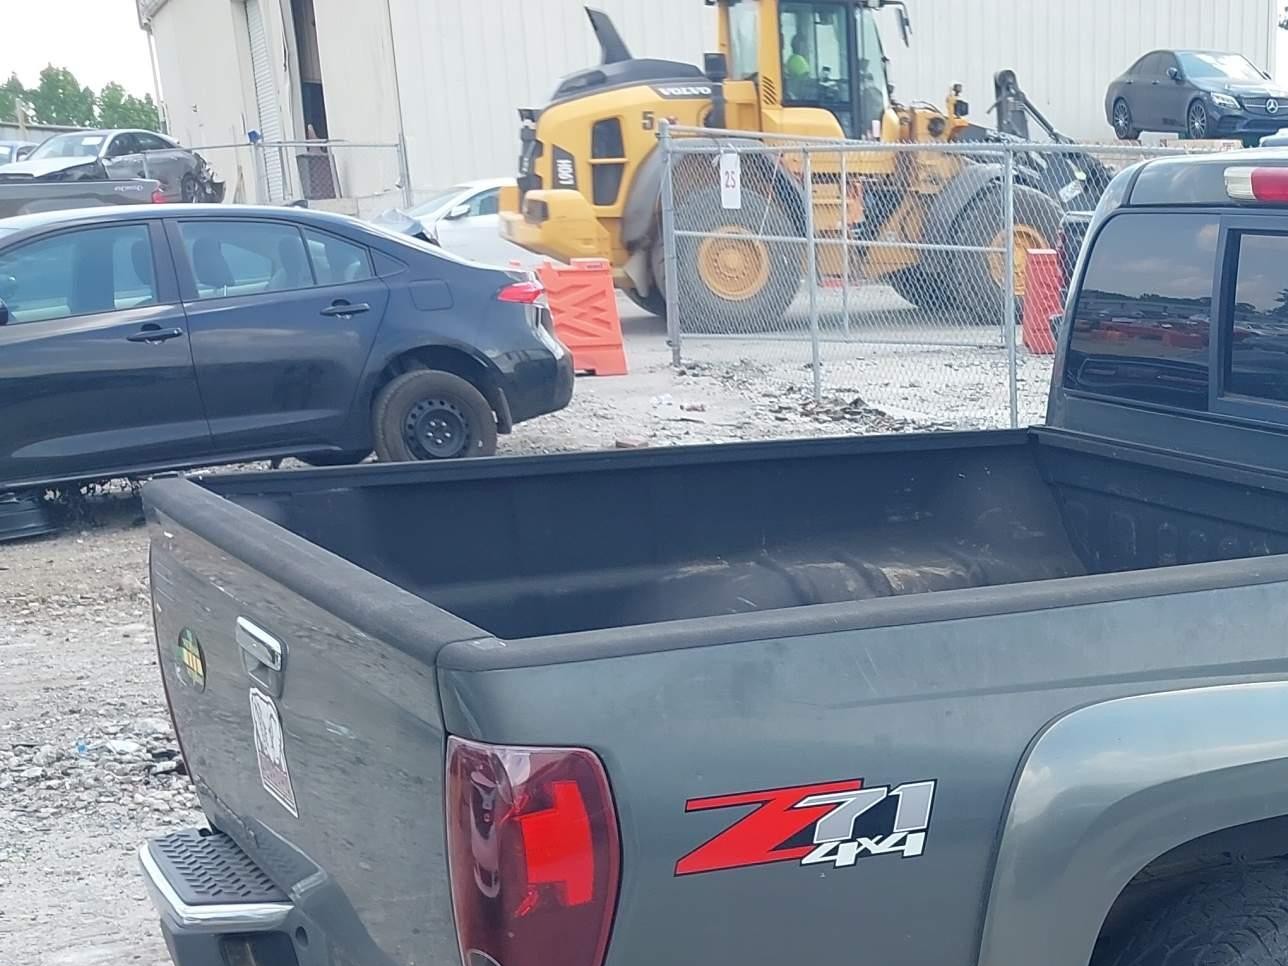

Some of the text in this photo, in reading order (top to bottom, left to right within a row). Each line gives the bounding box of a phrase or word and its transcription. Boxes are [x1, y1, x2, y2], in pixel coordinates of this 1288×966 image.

[658, 86, 712, 96] VOLVO
[642, 111, 655, 131] 5
[674, 777, 937, 876] Z71
[800, 831, 927, 869] 4x4
